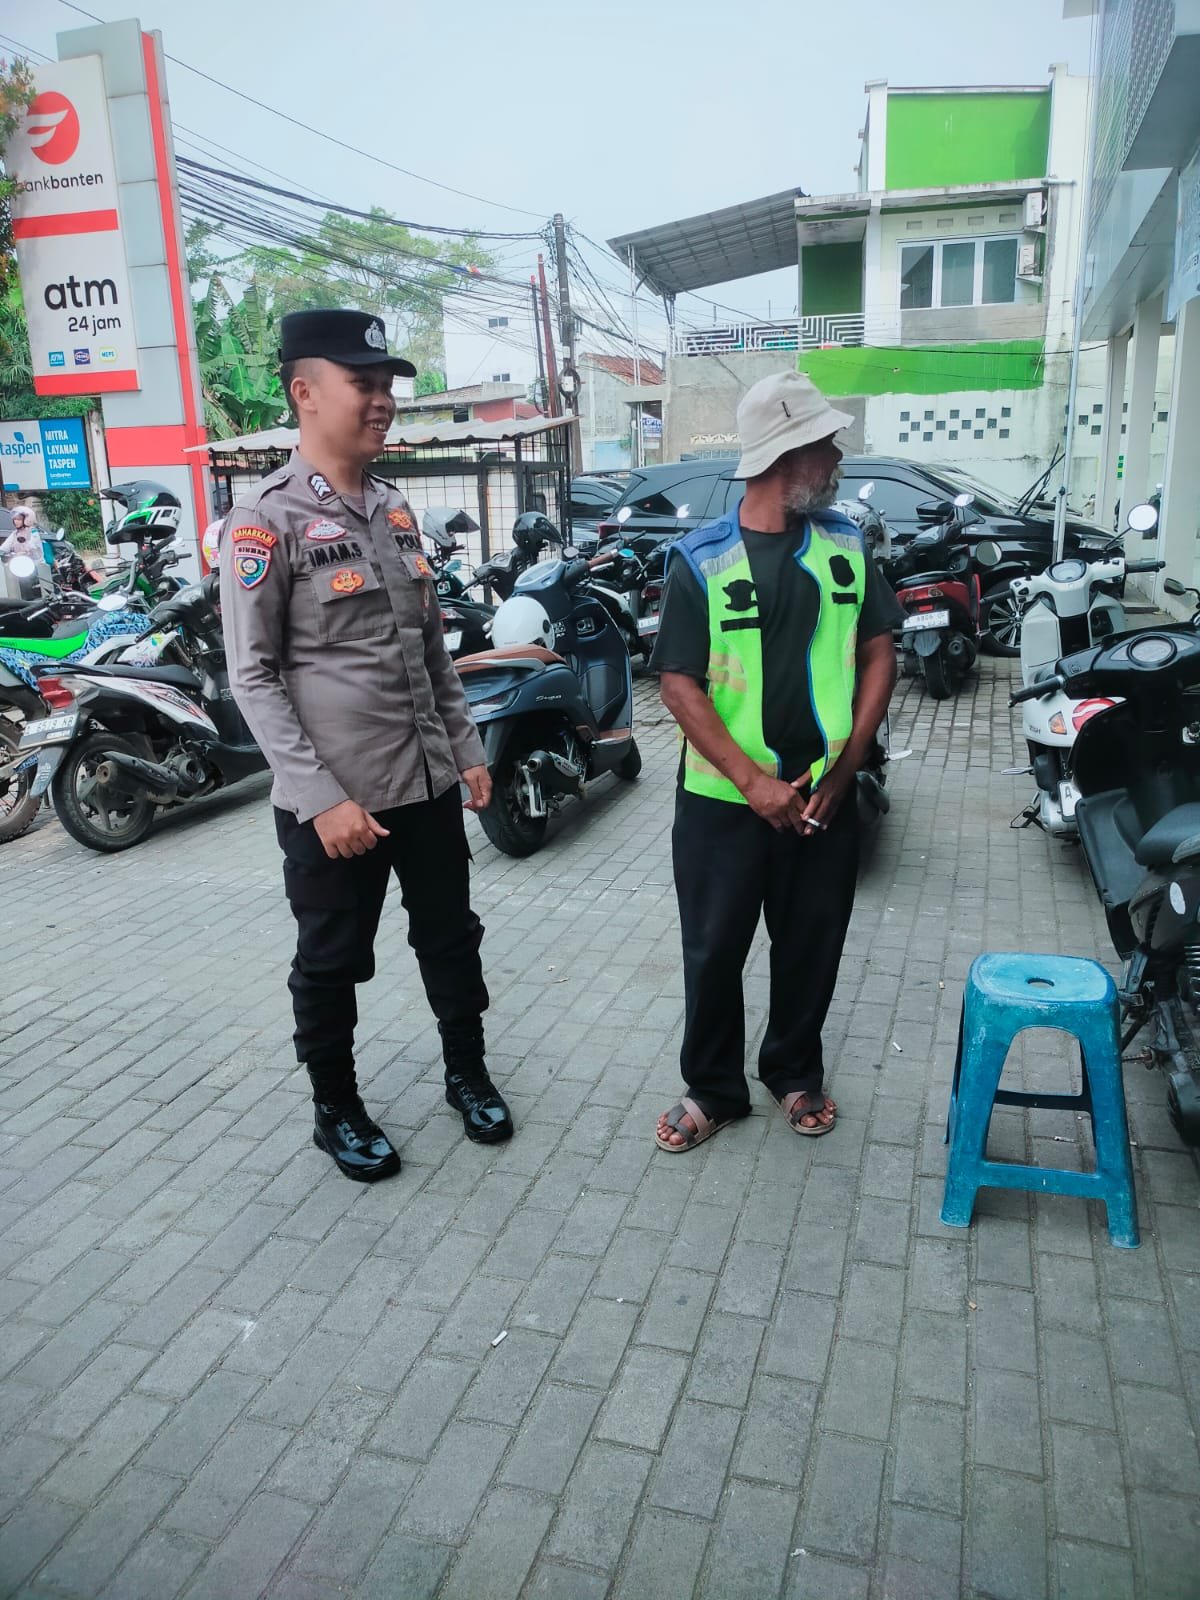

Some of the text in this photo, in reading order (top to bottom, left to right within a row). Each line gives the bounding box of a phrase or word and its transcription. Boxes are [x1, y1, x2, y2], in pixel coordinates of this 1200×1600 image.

[17, 173, 104, 192] ankbanten
[44, 275, 118, 310] atm
[68, 315, 121, 336] 24 jam
[45, 430, 69, 440] MITRA
[0, 442, 41, 457] taspen
[47, 444, 79, 455] LAYANAN
[49, 459, 76, 469] TASPEN
